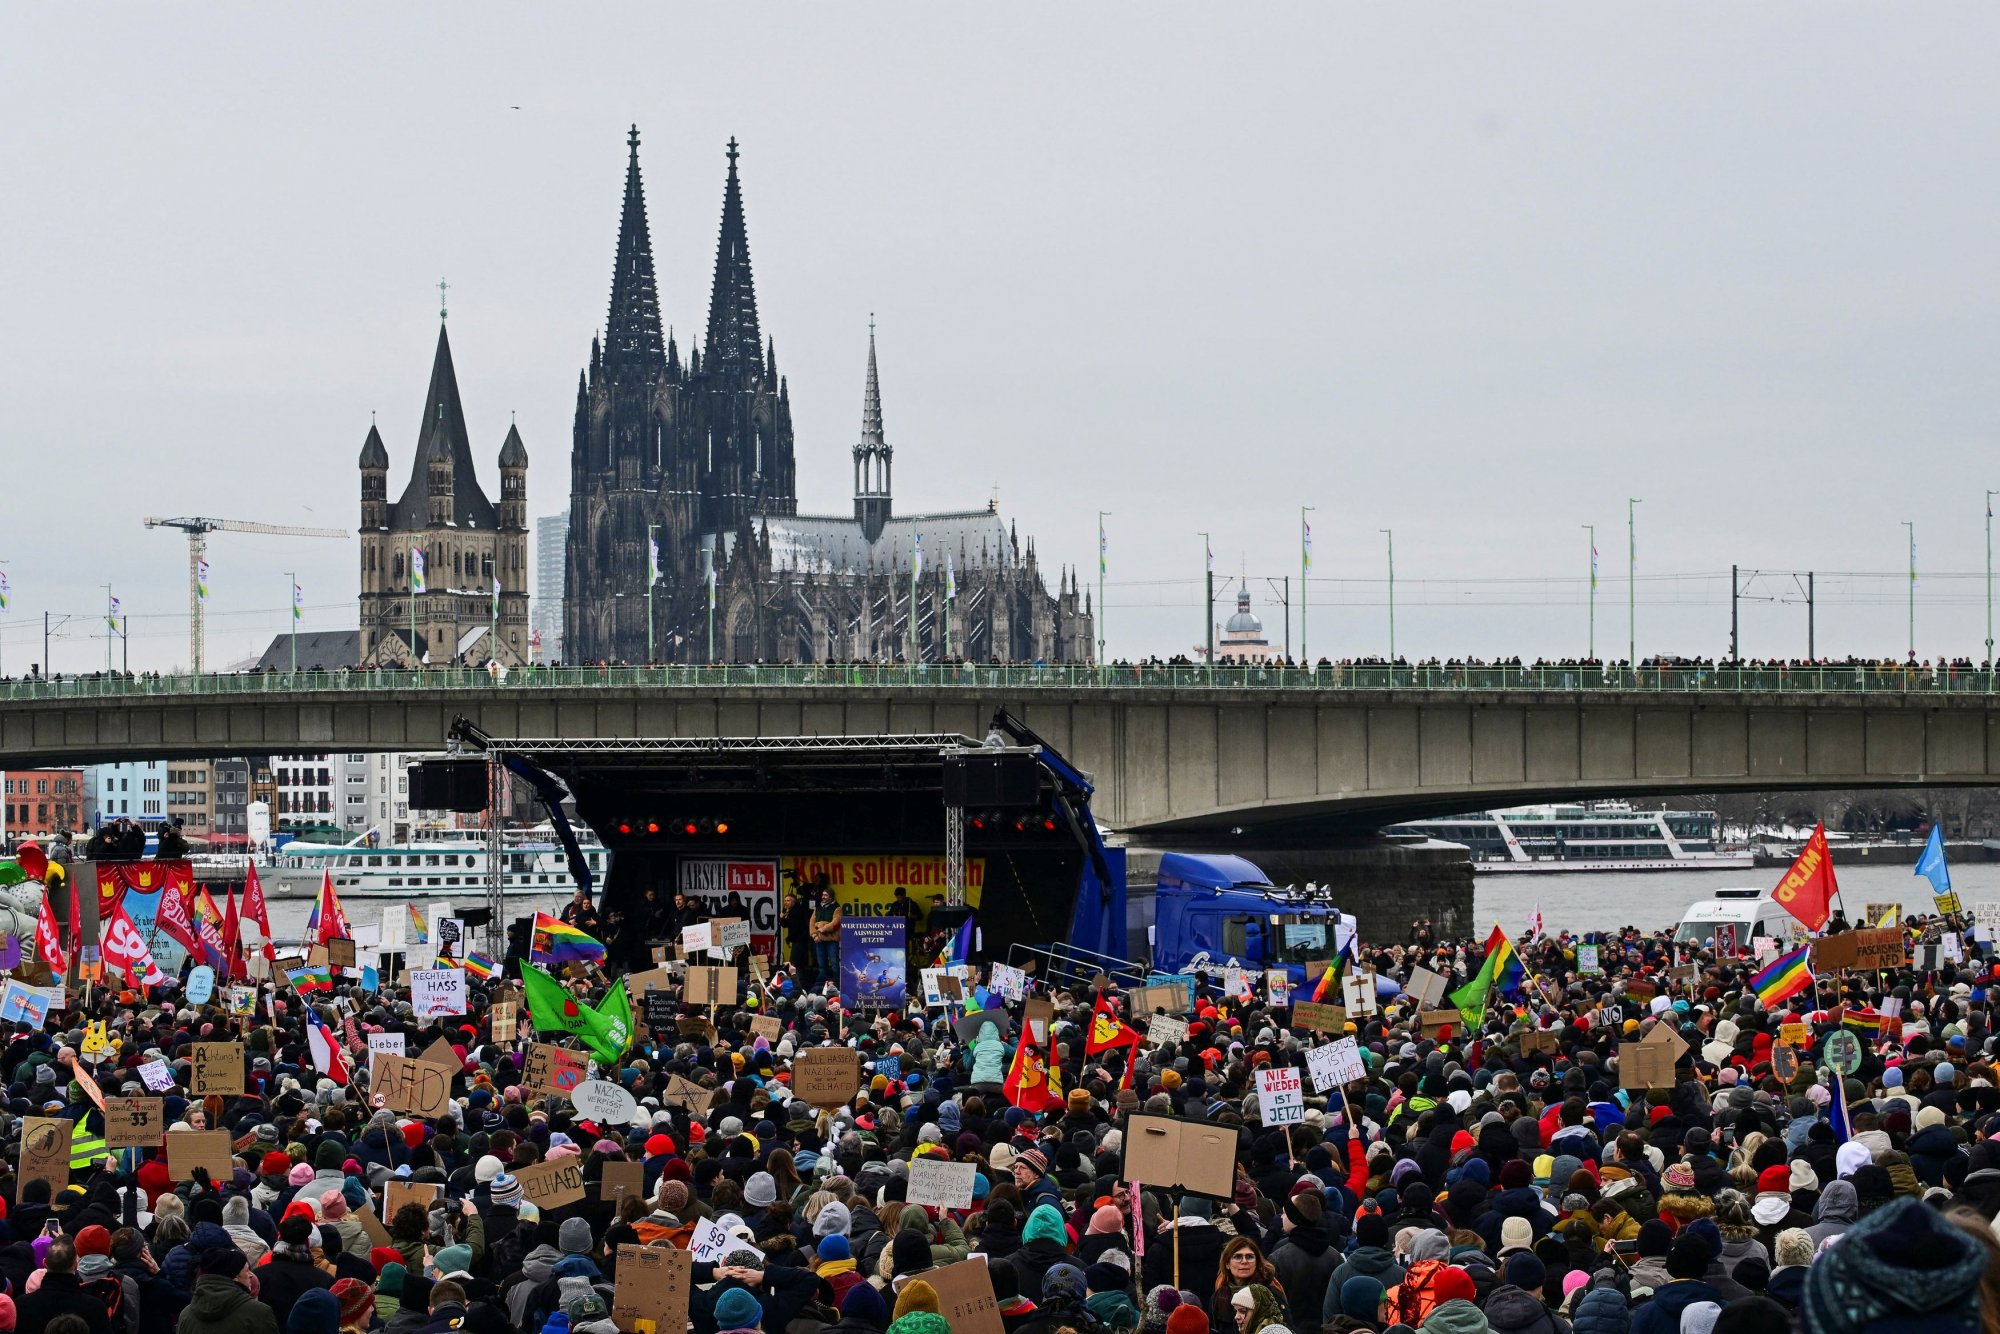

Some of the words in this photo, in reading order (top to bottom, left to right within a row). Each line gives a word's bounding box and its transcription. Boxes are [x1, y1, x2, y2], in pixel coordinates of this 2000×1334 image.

[684, 863, 727, 891] ARSCH
[732, 869, 771, 888] huh,
[793, 857, 845, 886] Köln
[852, 857, 983, 887] solidarish
[1857, 942, 1904, 955] FASCHISMUS
[1881, 954, 1899, 965] AFD
[413, 971, 453, 980] RECHTER
[428, 980, 458, 992] HASS
[369, 1038, 404, 1049] Lieber
[1305, 1036, 1356, 1063] RASSISMUS
[528, 1046, 547, 1061] Kein
[803, 1054, 825, 1065] ALLE
[827, 1053, 855, 1064] HASSEN
[1328, 1051, 1346, 1067] IST
[525, 1059, 549, 1075] Bock
[147, 1073, 176, 1092] NEIN!
[1266, 1069, 1289, 1082] NIE
[594, 1083, 623, 1103] NAZIS
[1264, 1079, 1299, 1093] WIEDER
[125, 1098, 141, 1111] 24
[587, 1094, 624, 1110] VERPISST
[1274, 1093, 1292, 1105] IST
[130, 1111, 148, 1126] 33
[593, 1105, 619, 1118] EUCH!
[1269, 1105, 1304, 1122] JETZT
[708, 1226, 726, 1248] §9
[690, 1238, 714, 1259] WAT
